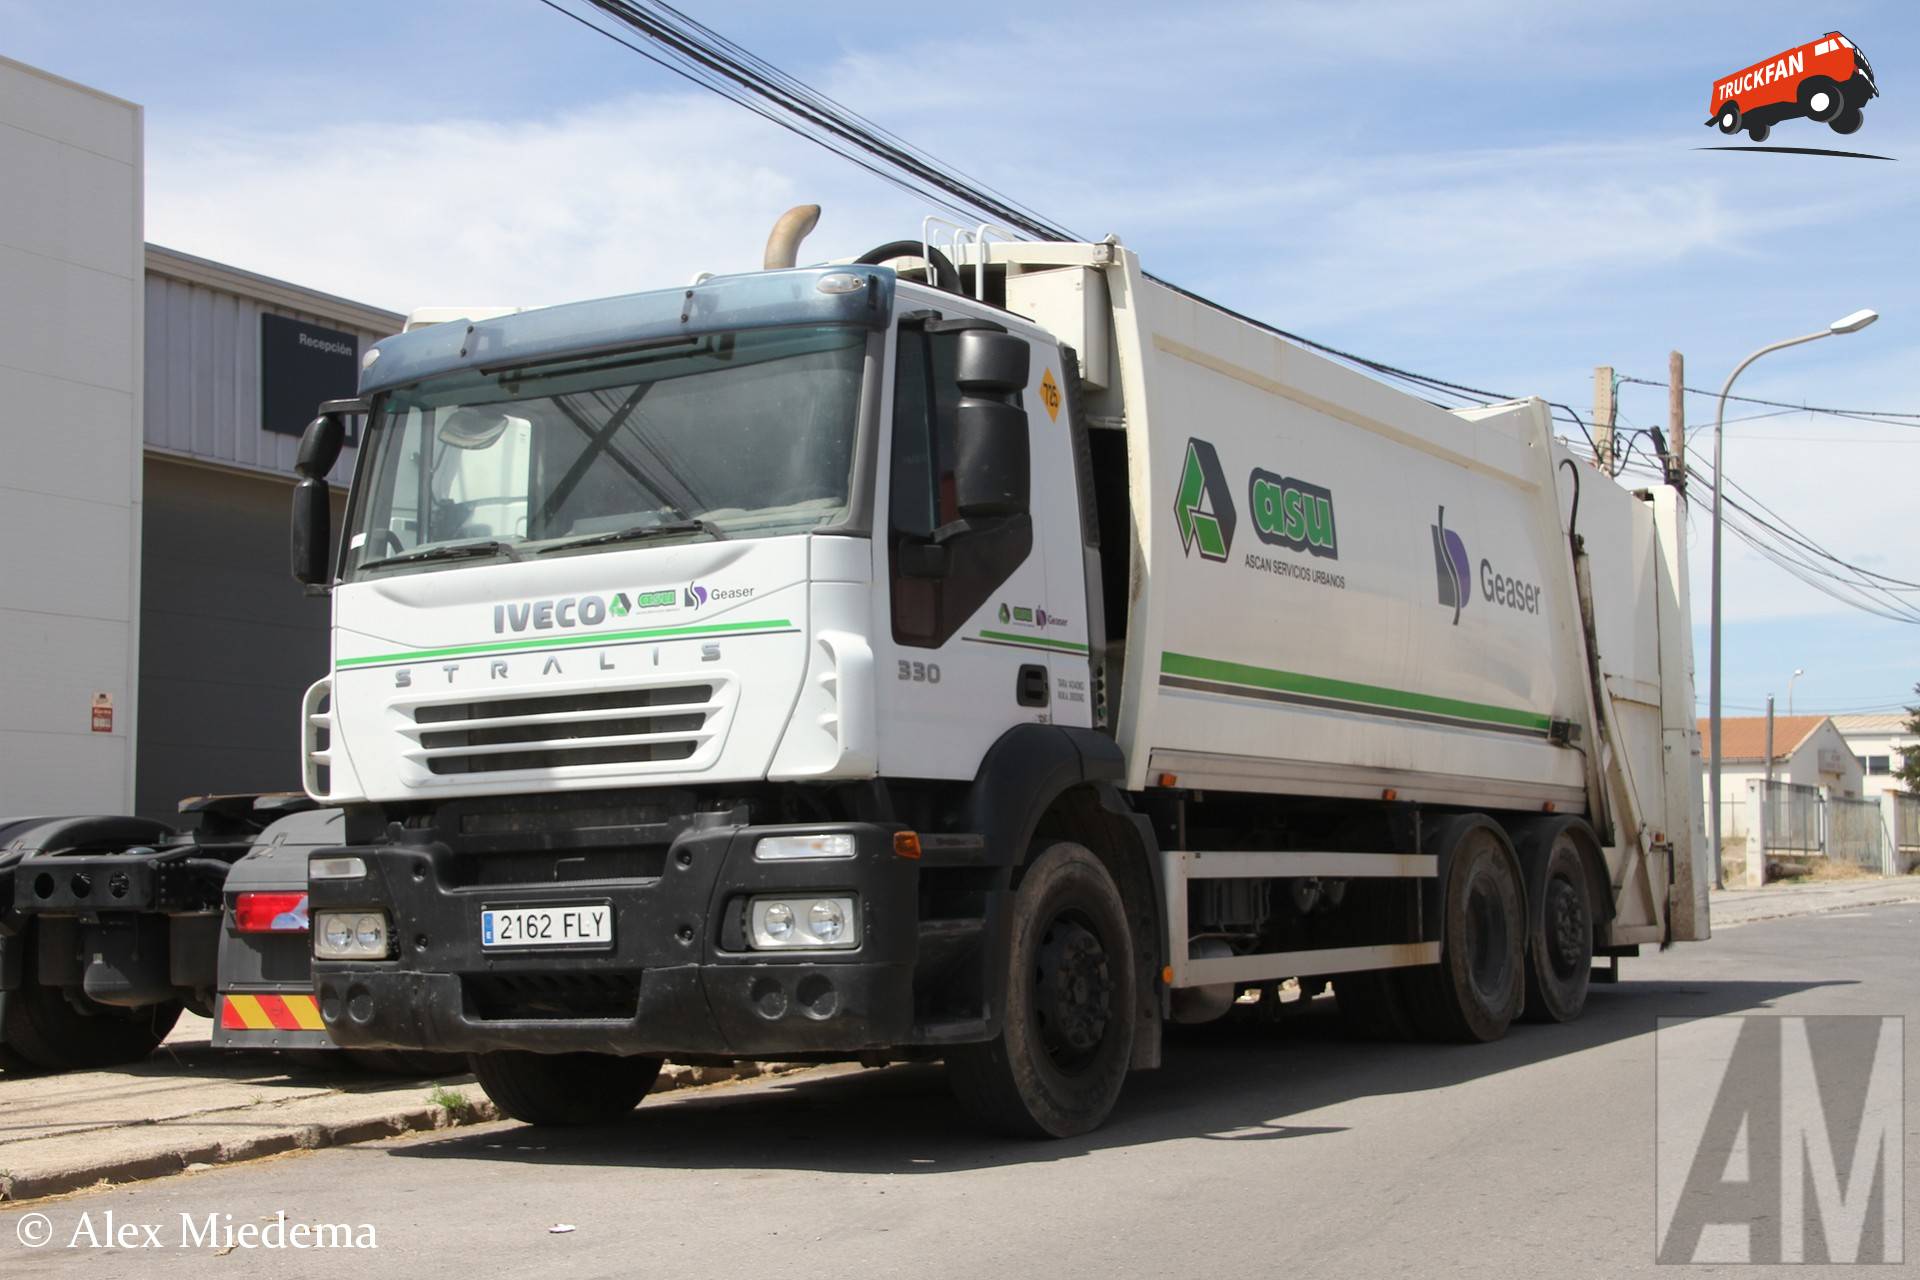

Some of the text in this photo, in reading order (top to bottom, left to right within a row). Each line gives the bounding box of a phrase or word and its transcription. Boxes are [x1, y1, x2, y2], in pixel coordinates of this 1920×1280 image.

[299, 332, 353, 356] Recepción
[1253, 478, 1334, 549] asu
[1245, 553, 1345, 589] ASCAN SERVICIOS URBANOS
[1480, 558, 1540, 616] Geaser
[711, 587, 755, 600] Geaser
[494, 595, 606, 634] IVECO
[395, 642, 721, 688] STRALIS
[897, 659, 941, 684] 330
[500, 912, 604, 939] 2162 FLY
